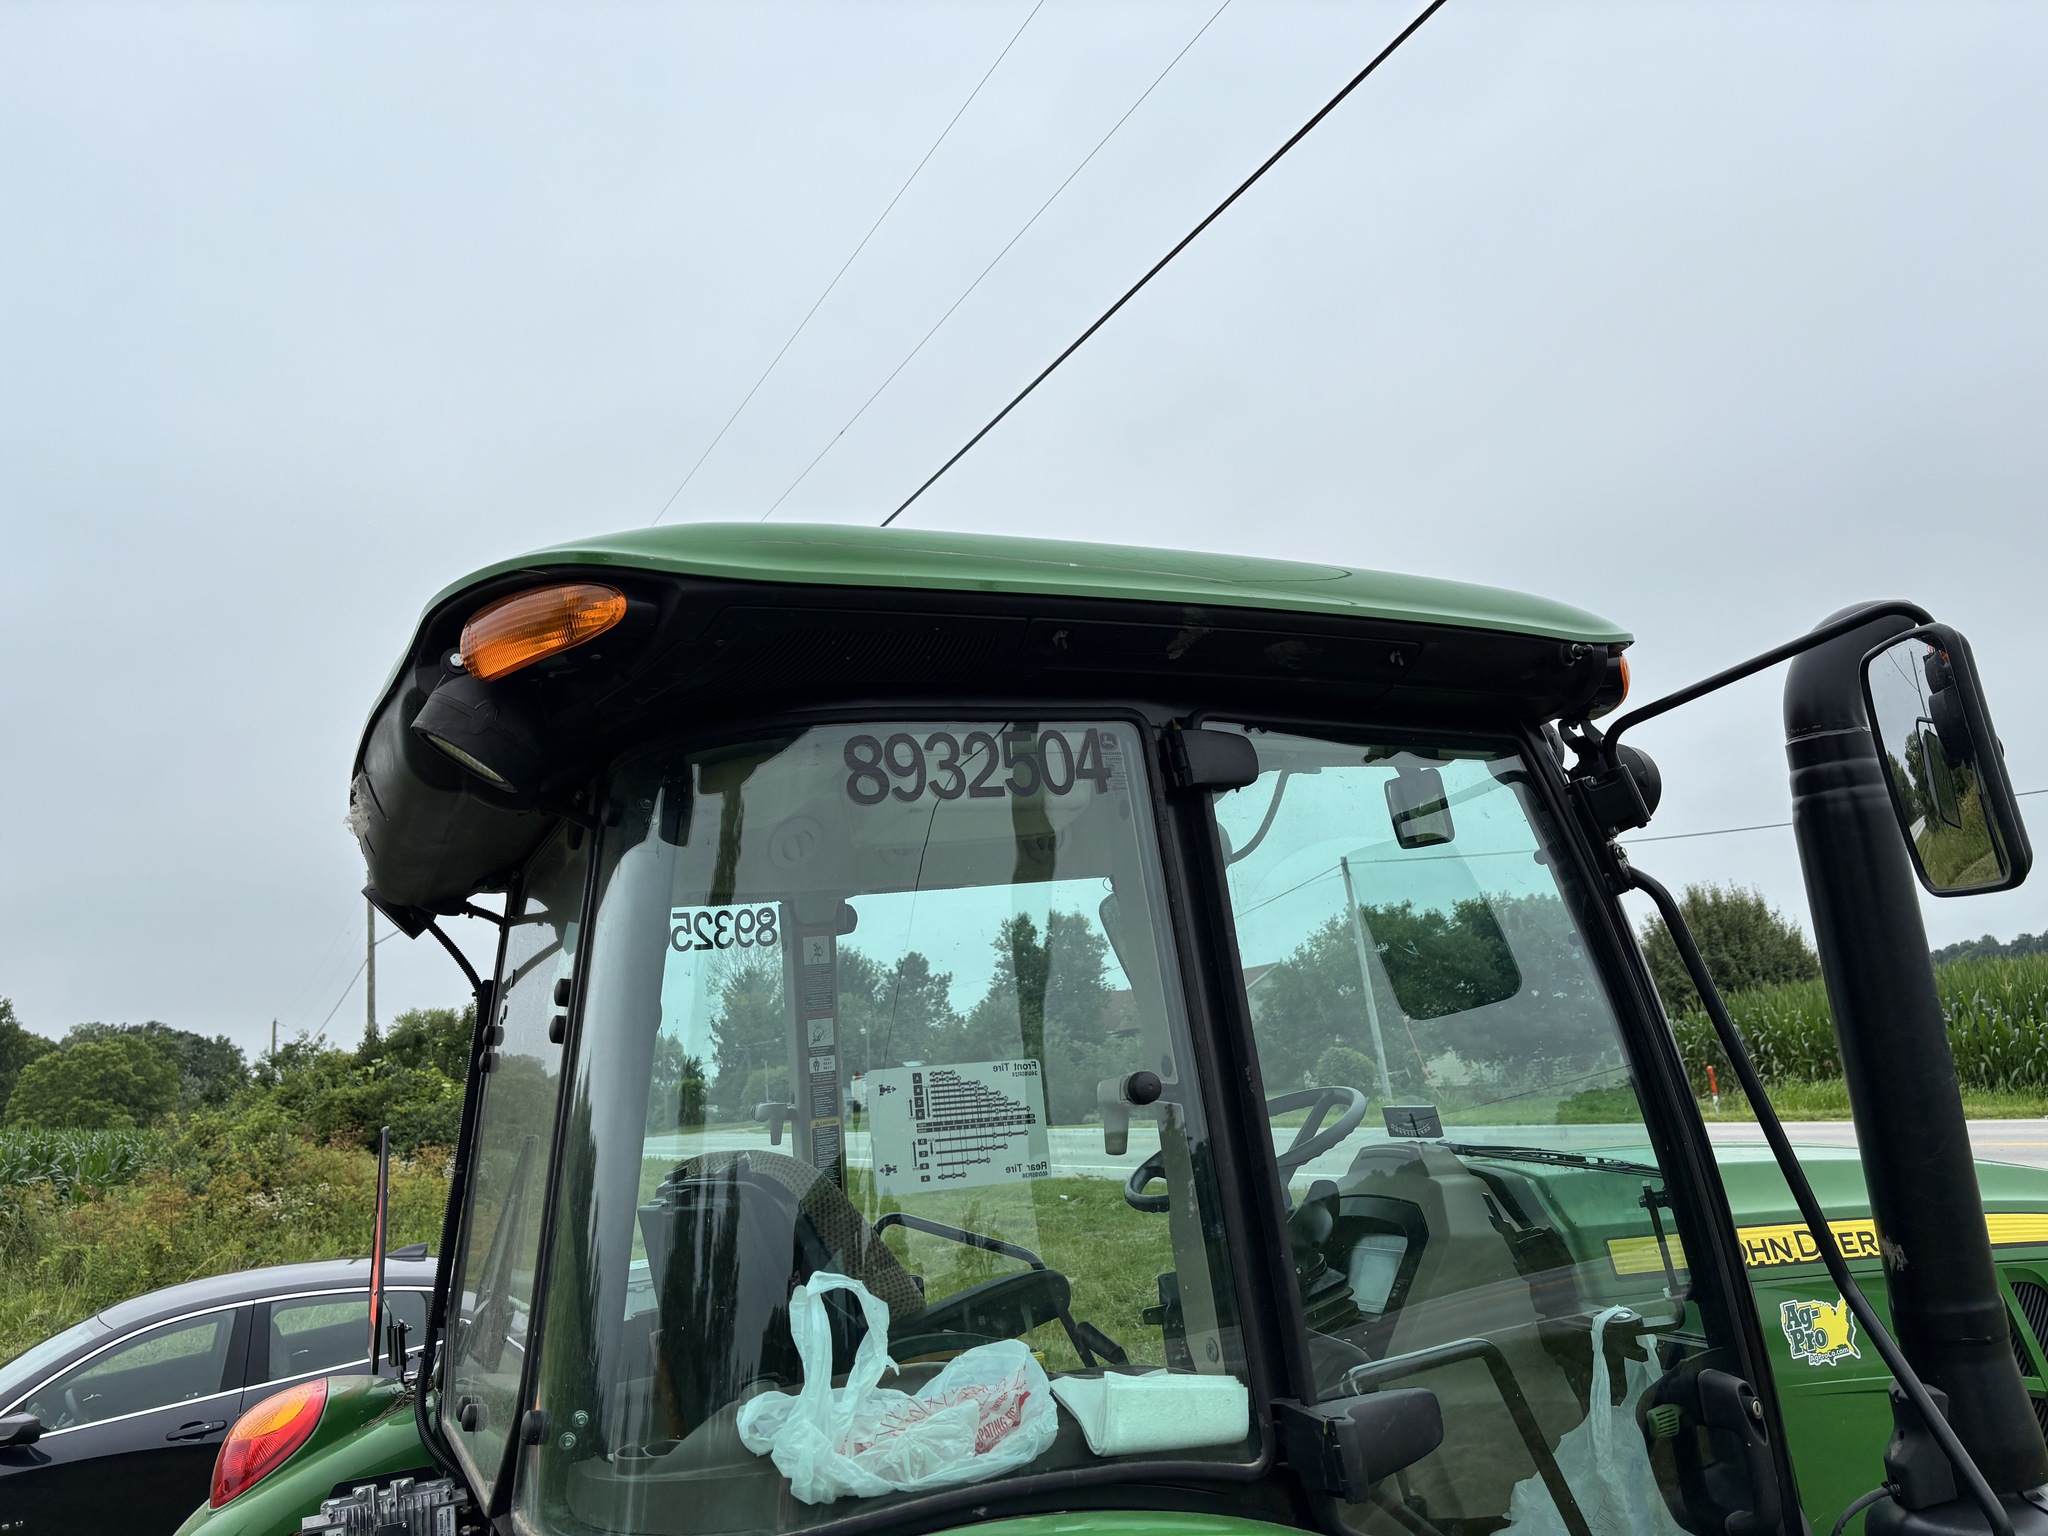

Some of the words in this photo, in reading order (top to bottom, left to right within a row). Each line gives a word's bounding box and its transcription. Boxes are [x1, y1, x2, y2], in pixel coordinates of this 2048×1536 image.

[843, 728, 1112, 805] 8932504
[1785, 1304, 1820, 1331] Ag-
[1790, 1327, 1828, 1355] Pro
[1809, 1347, 1850, 1363] AgProCo.com
